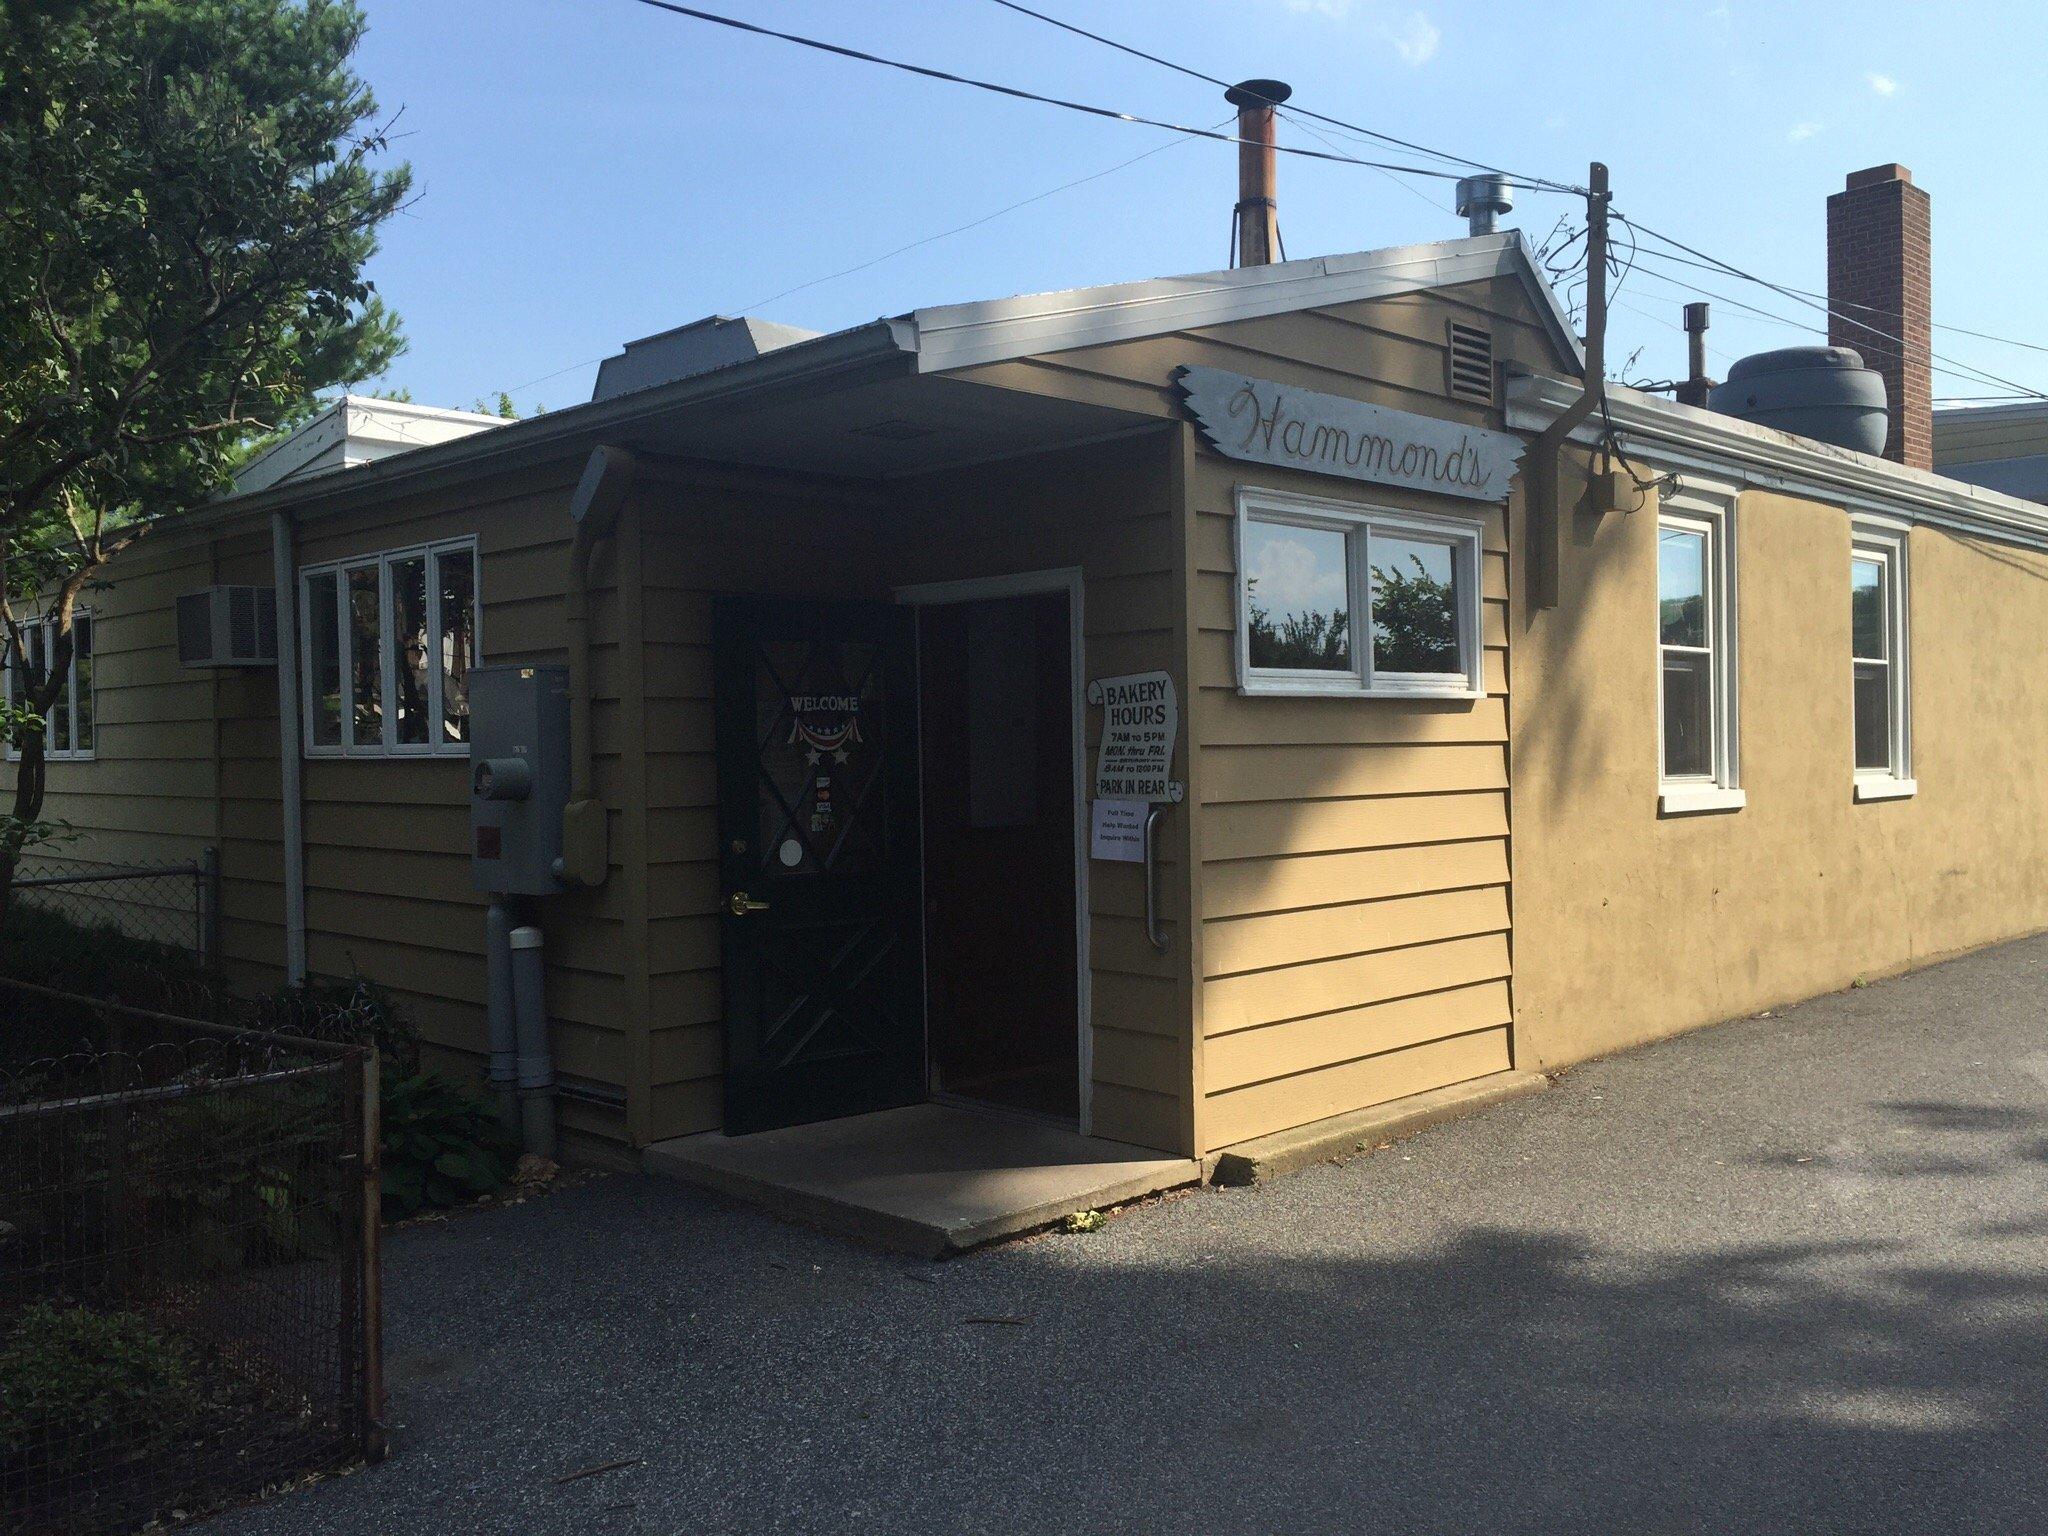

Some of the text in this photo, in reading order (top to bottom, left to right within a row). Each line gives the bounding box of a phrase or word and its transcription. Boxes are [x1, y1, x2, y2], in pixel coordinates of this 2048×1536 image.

[1228, 382, 1491, 487] Hammond's
[1106, 679, 1167, 706] BAKERY
[791, 697, 859, 712] WELCOME
[1112, 705, 1166, 726] HOURS
[1111, 732, 1130, 742] 7AM
[1105, 746, 1125, 756] MON.
[1148, 746, 1165, 756] FRI.
[1104, 764, 1123, 772] 8AM
[1100, 780, 1165, 794] PARK IN REAR
[1102, 822, 1116, 830] Help
[1100, 834, 1121, 842] Inquire
